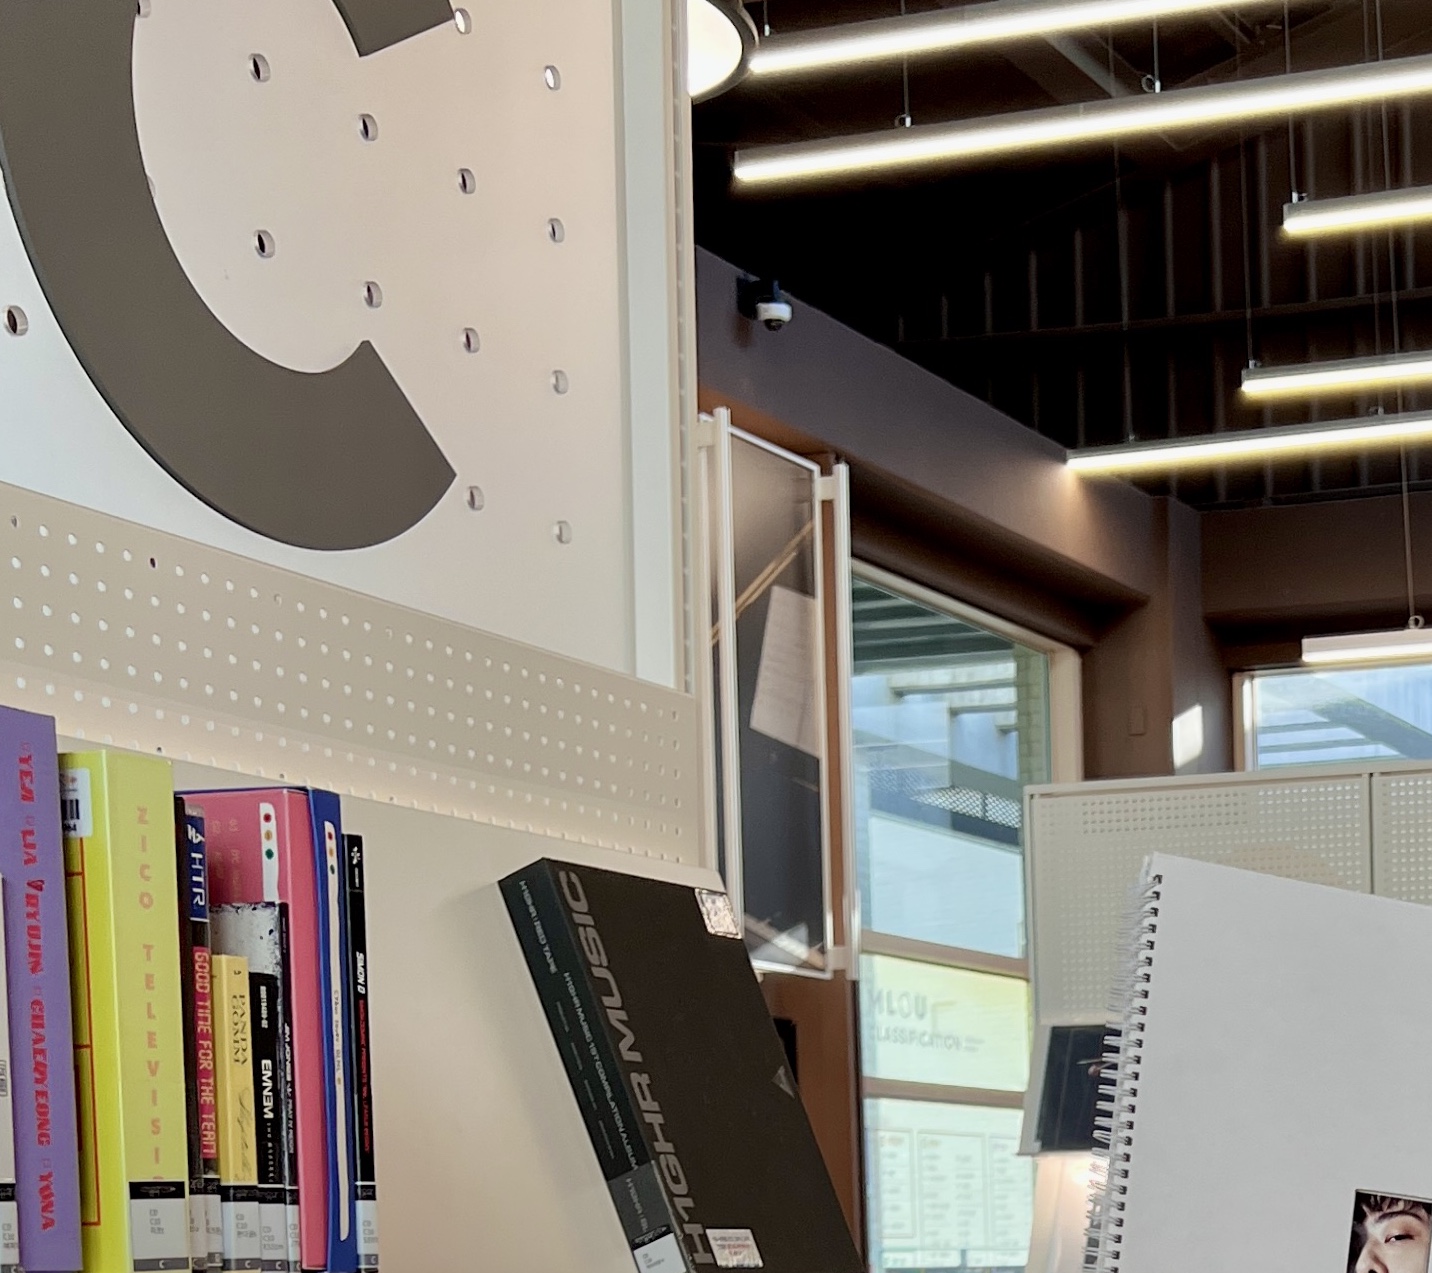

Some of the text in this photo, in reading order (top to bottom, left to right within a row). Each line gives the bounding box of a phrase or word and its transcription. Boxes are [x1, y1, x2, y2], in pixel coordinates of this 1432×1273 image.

[194, 951, 210, 993] GOOD
[558, 869, 643, 1063] MUSIC
[199, 1040, 213, 1070] FOR
[200, 1076, 215, 1105] THE
[202, 1111, 217, 1155] TEAM
[594, 1059, 624, 1133] COMPILATION
[619, 1129, 639, 1171] ALBUM
[38, 1171, 57, 1231] YUNA
